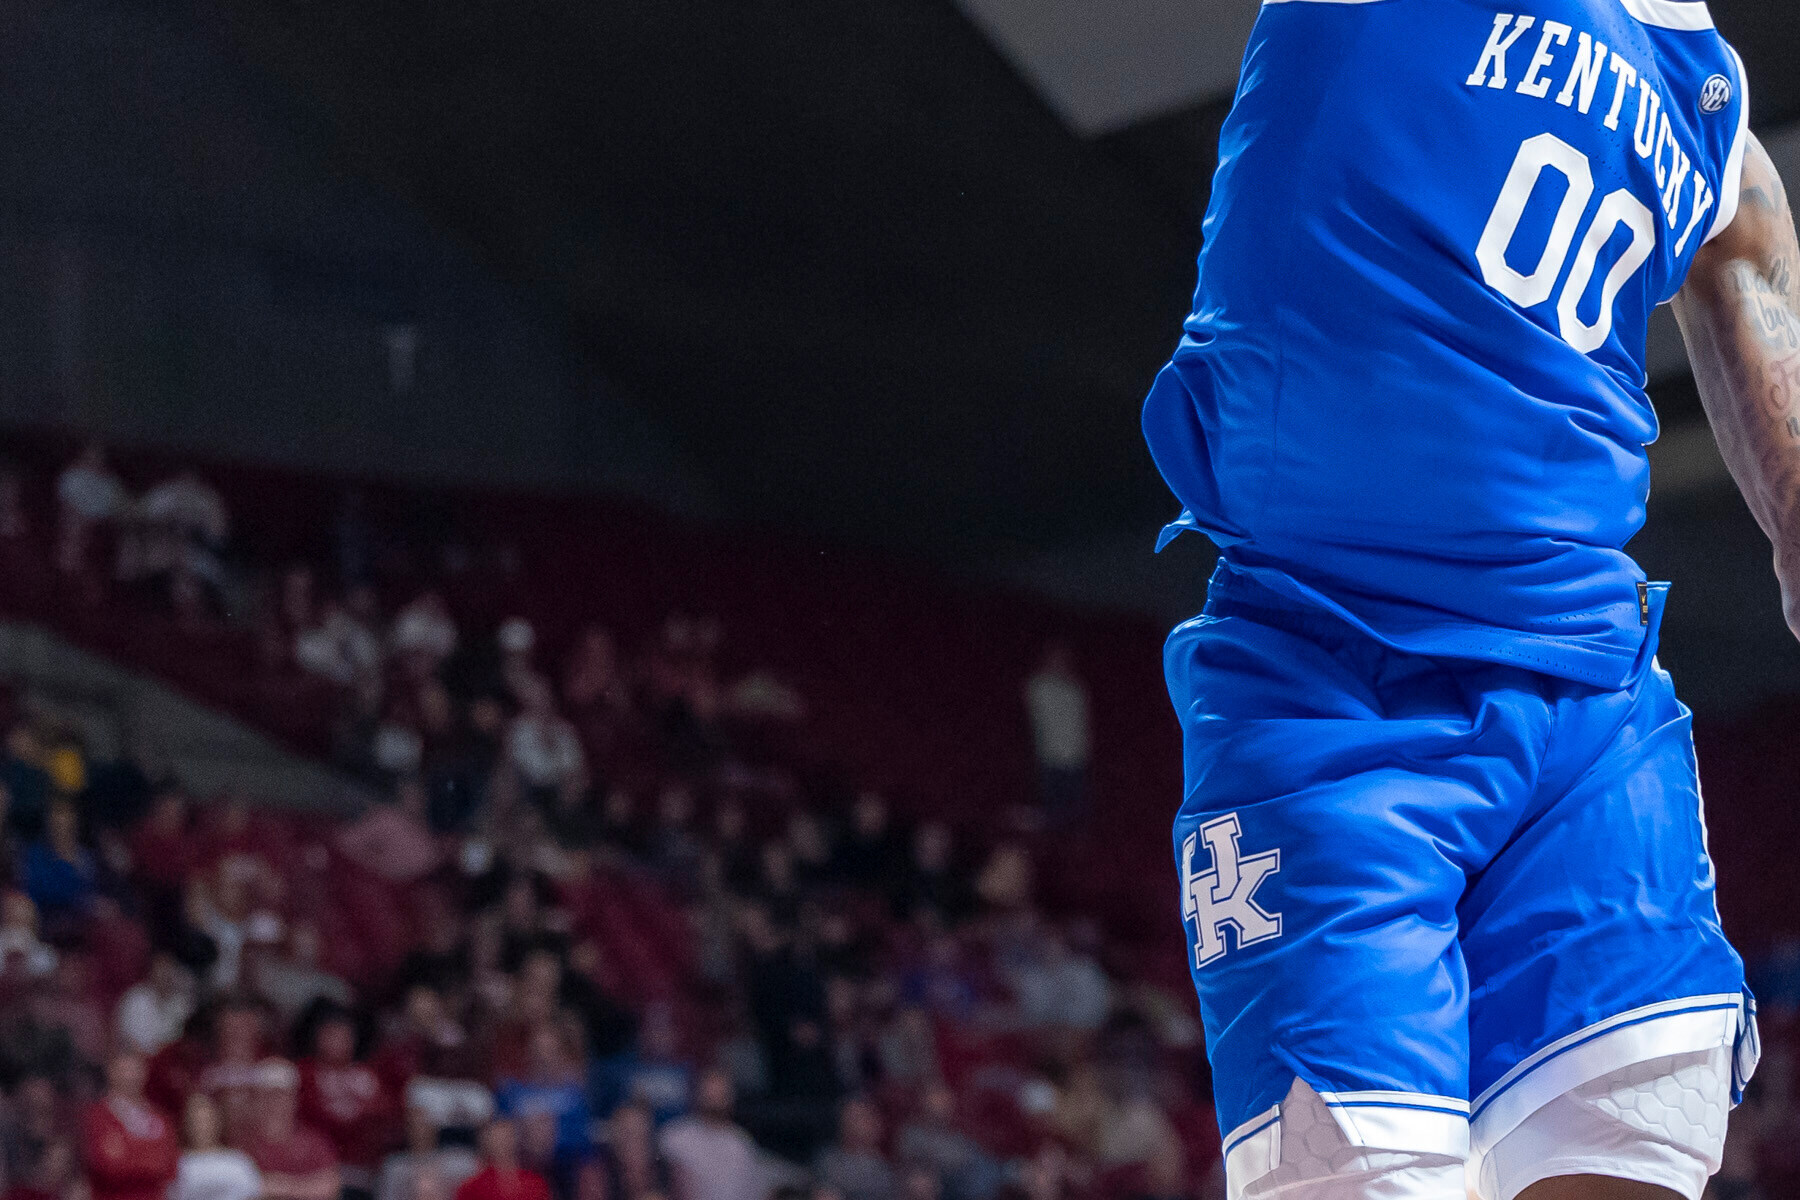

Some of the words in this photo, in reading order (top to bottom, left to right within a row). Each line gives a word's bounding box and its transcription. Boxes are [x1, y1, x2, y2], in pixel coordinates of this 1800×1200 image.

[1466, 13, 1714, 257] KENTUCKY
[1702, 77, 1730, 112] SEC
[1475, 132, 1656, 355] 00
[1757, 295, 1797, 349] by
